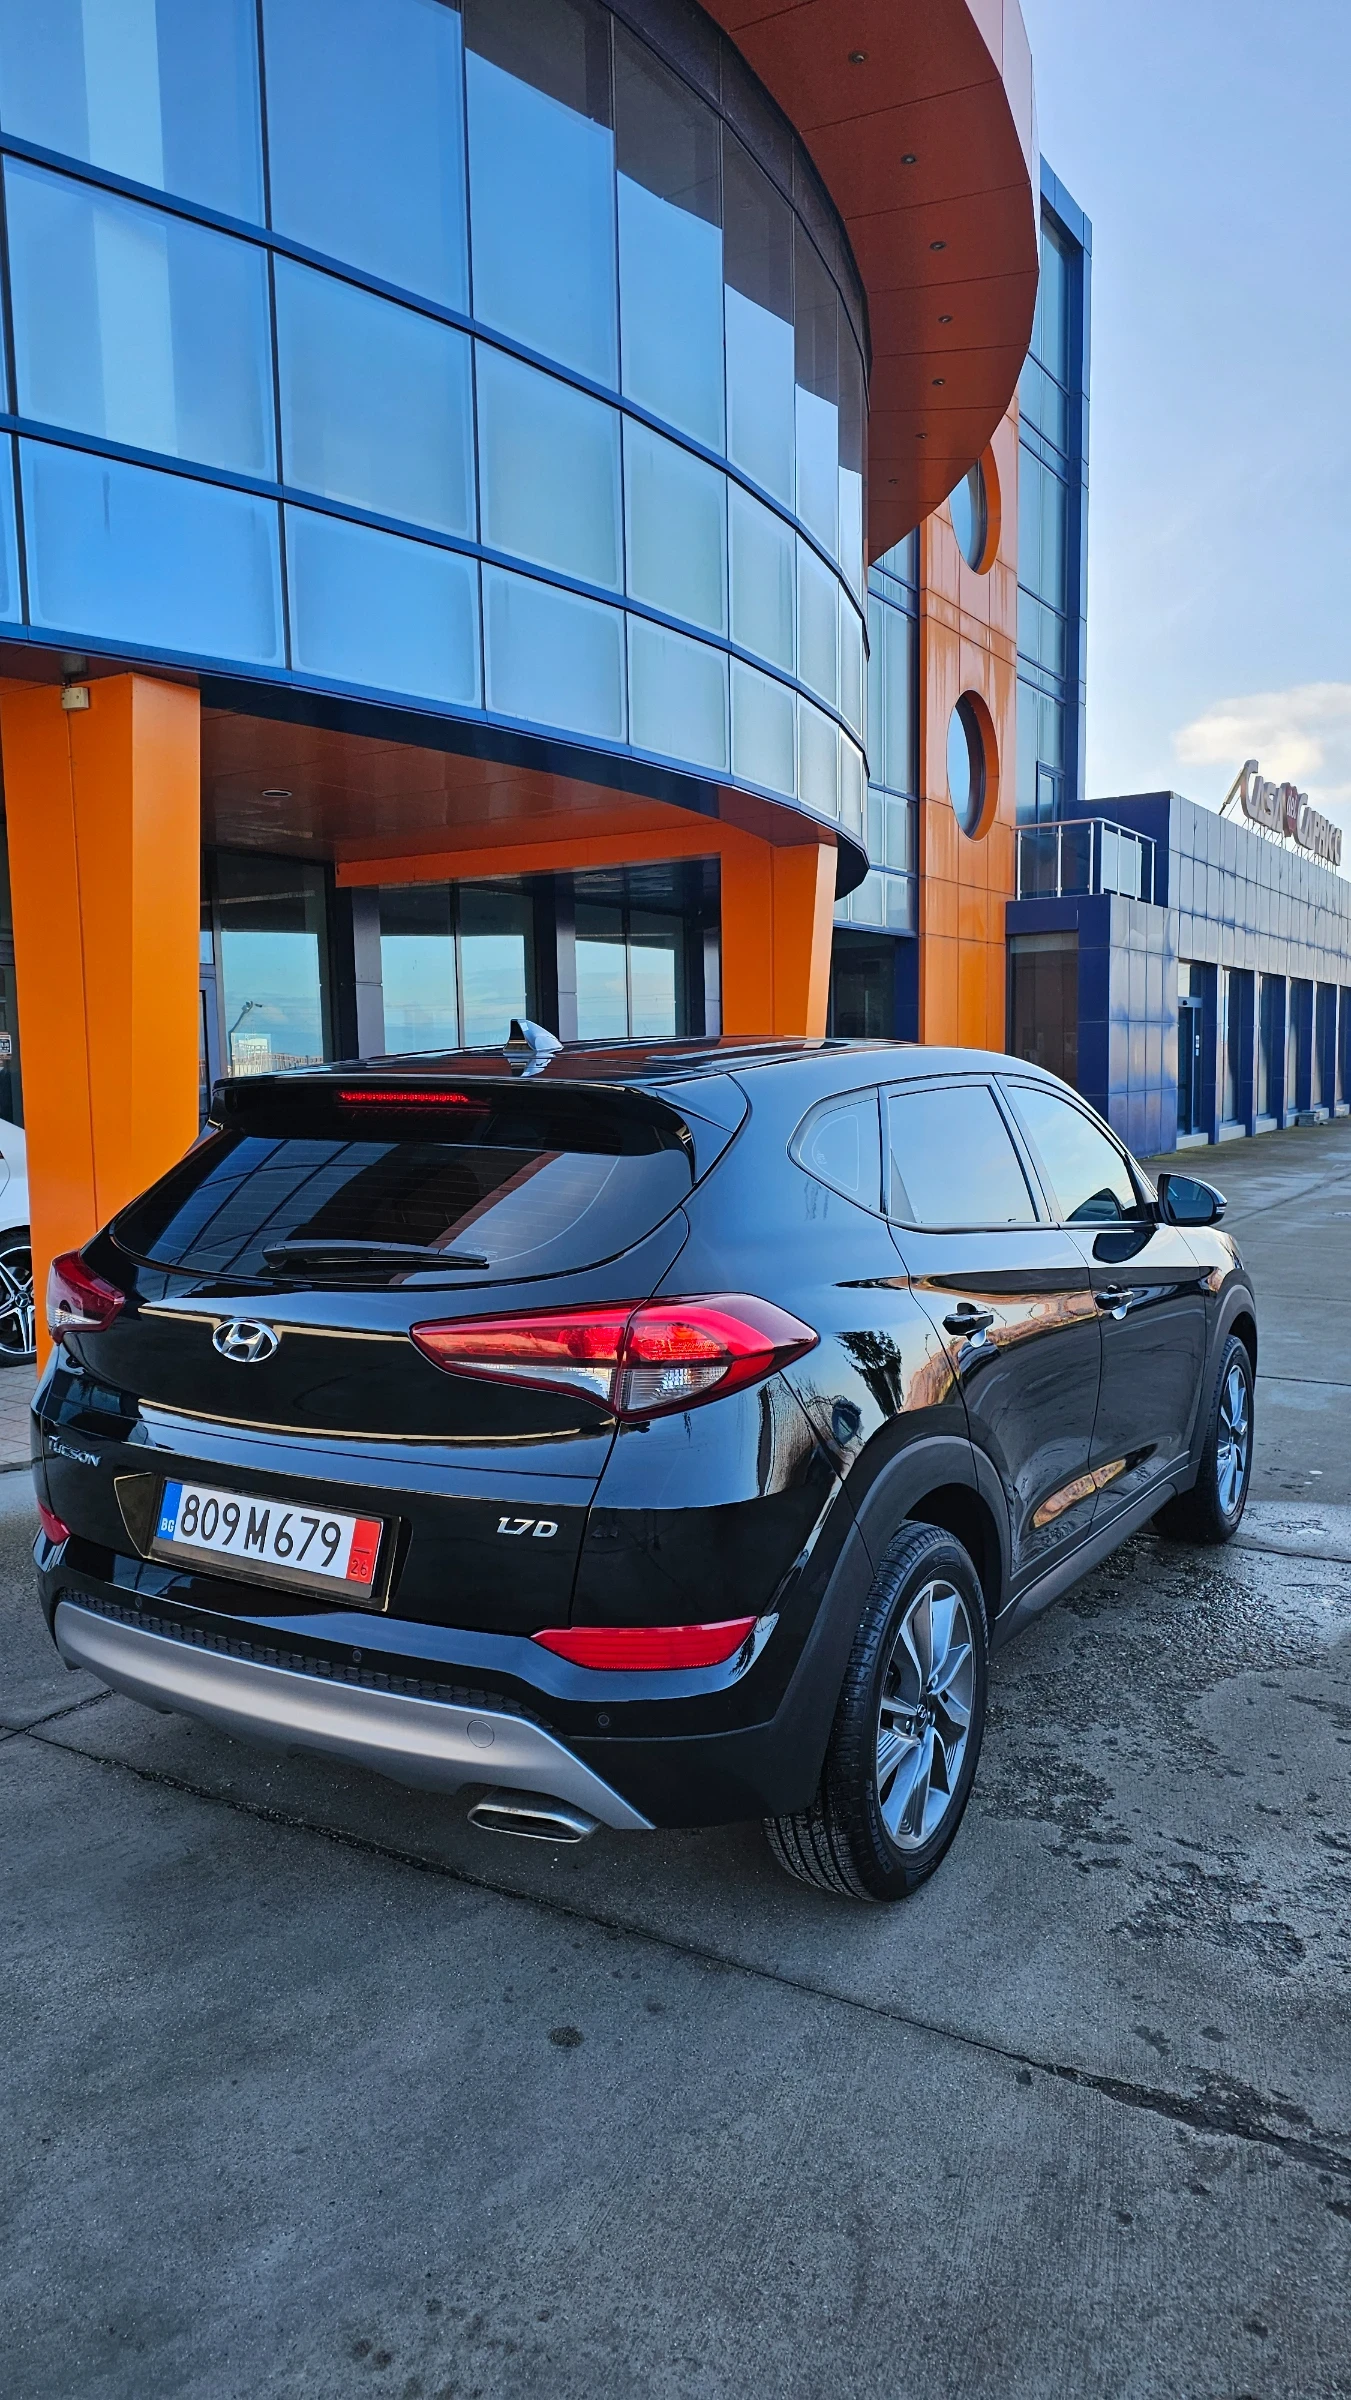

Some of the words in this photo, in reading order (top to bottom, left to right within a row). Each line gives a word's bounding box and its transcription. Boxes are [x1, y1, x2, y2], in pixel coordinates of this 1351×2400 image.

[1240, 759, 1284, 834] CASA
[48, 1435, 101, 1467] TUCSON
[161, 1517, 175, 1533] BG
[180, 1494, 342, 1568] 809M679
[350, 1558, 368, 1576] 26
